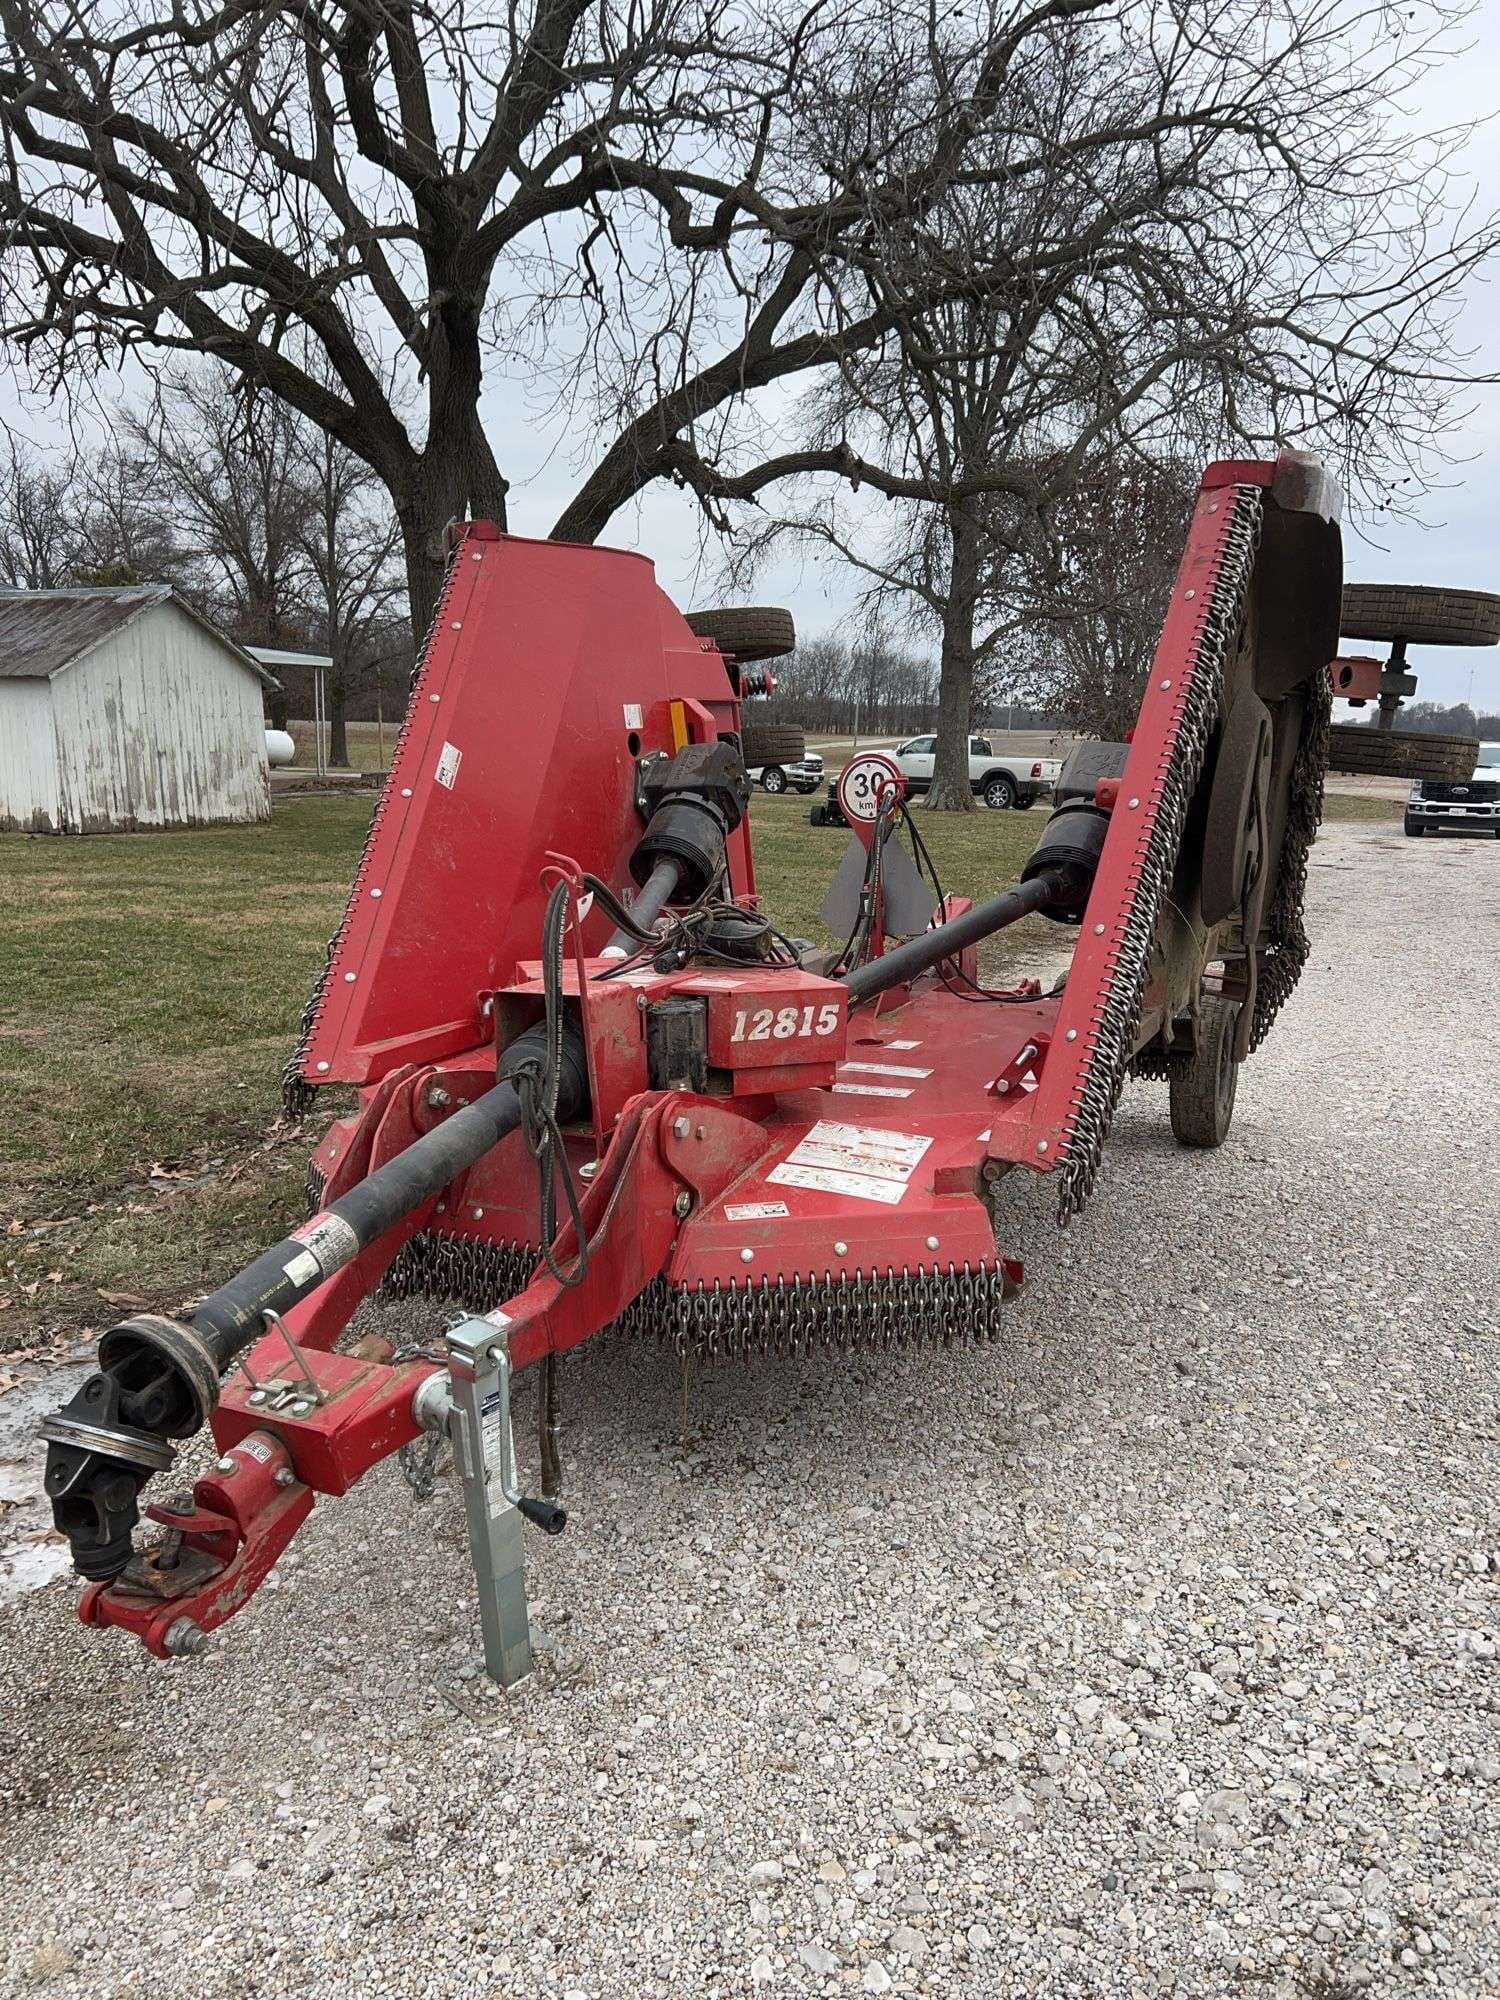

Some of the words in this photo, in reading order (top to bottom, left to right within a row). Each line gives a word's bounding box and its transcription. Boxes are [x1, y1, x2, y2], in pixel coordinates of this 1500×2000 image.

[854, 772, 885, 798] 30
[859, 800, 877, 810] km/
[730, 1004, 840, 1042] 12815
[257, 1447, 269, 1458] UP
